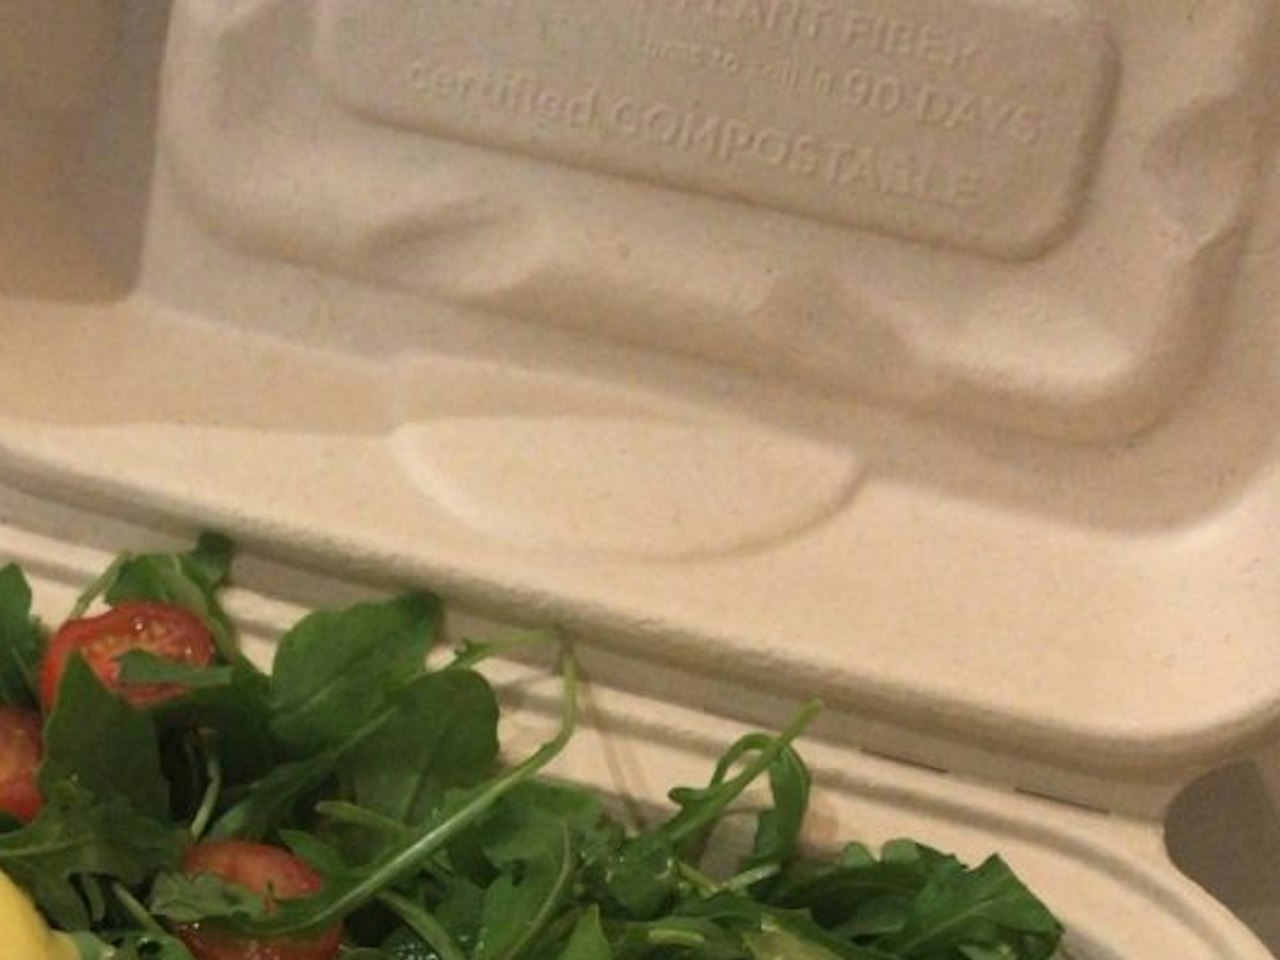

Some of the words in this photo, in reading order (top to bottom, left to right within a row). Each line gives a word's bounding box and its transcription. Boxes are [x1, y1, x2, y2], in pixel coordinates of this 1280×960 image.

[406, 60, 598, 128] certified
[610, 95, 983, 201] COMPOSTABLE
[844, 68, 906, 117] 90
[914, 84, 1042, 146] DAYS
